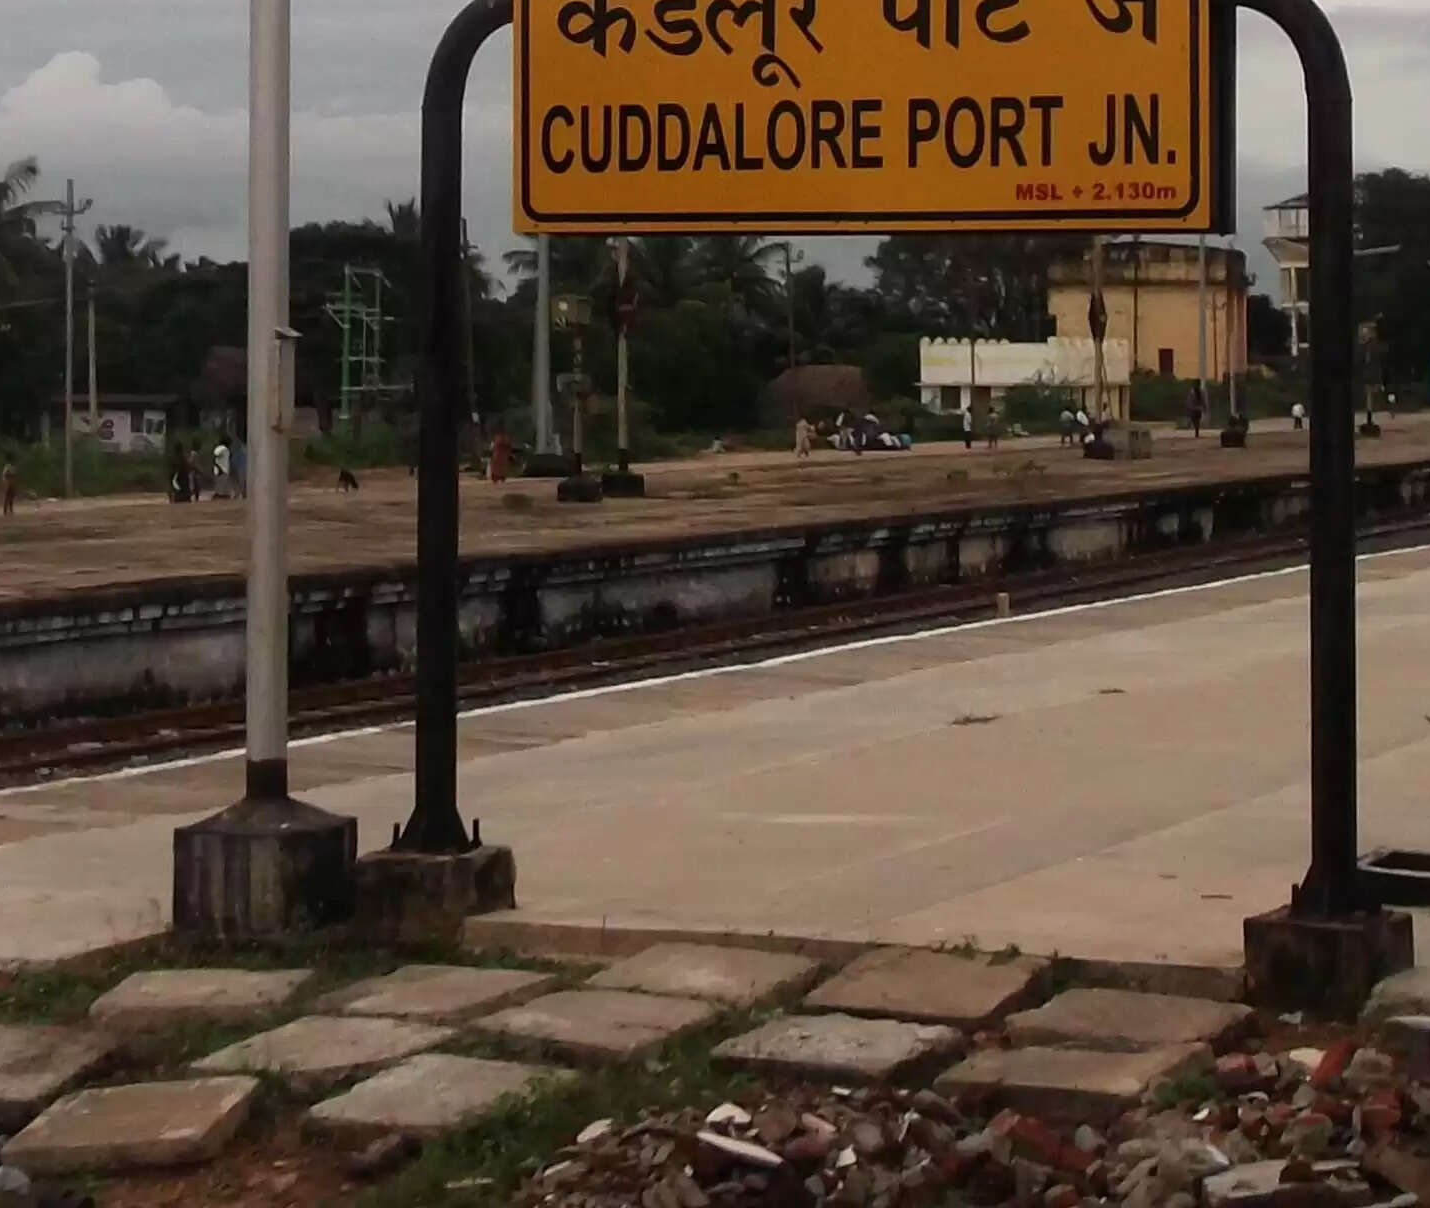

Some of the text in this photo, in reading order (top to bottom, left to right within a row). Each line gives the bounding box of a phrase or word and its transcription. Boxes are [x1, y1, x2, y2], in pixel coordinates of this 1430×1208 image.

[541, 93, 1176, 174] CUDDALORE PORT JN.
[1015, 183, 1063, 201] MSL
[1091, 181, 1177, 201] 2.130m
